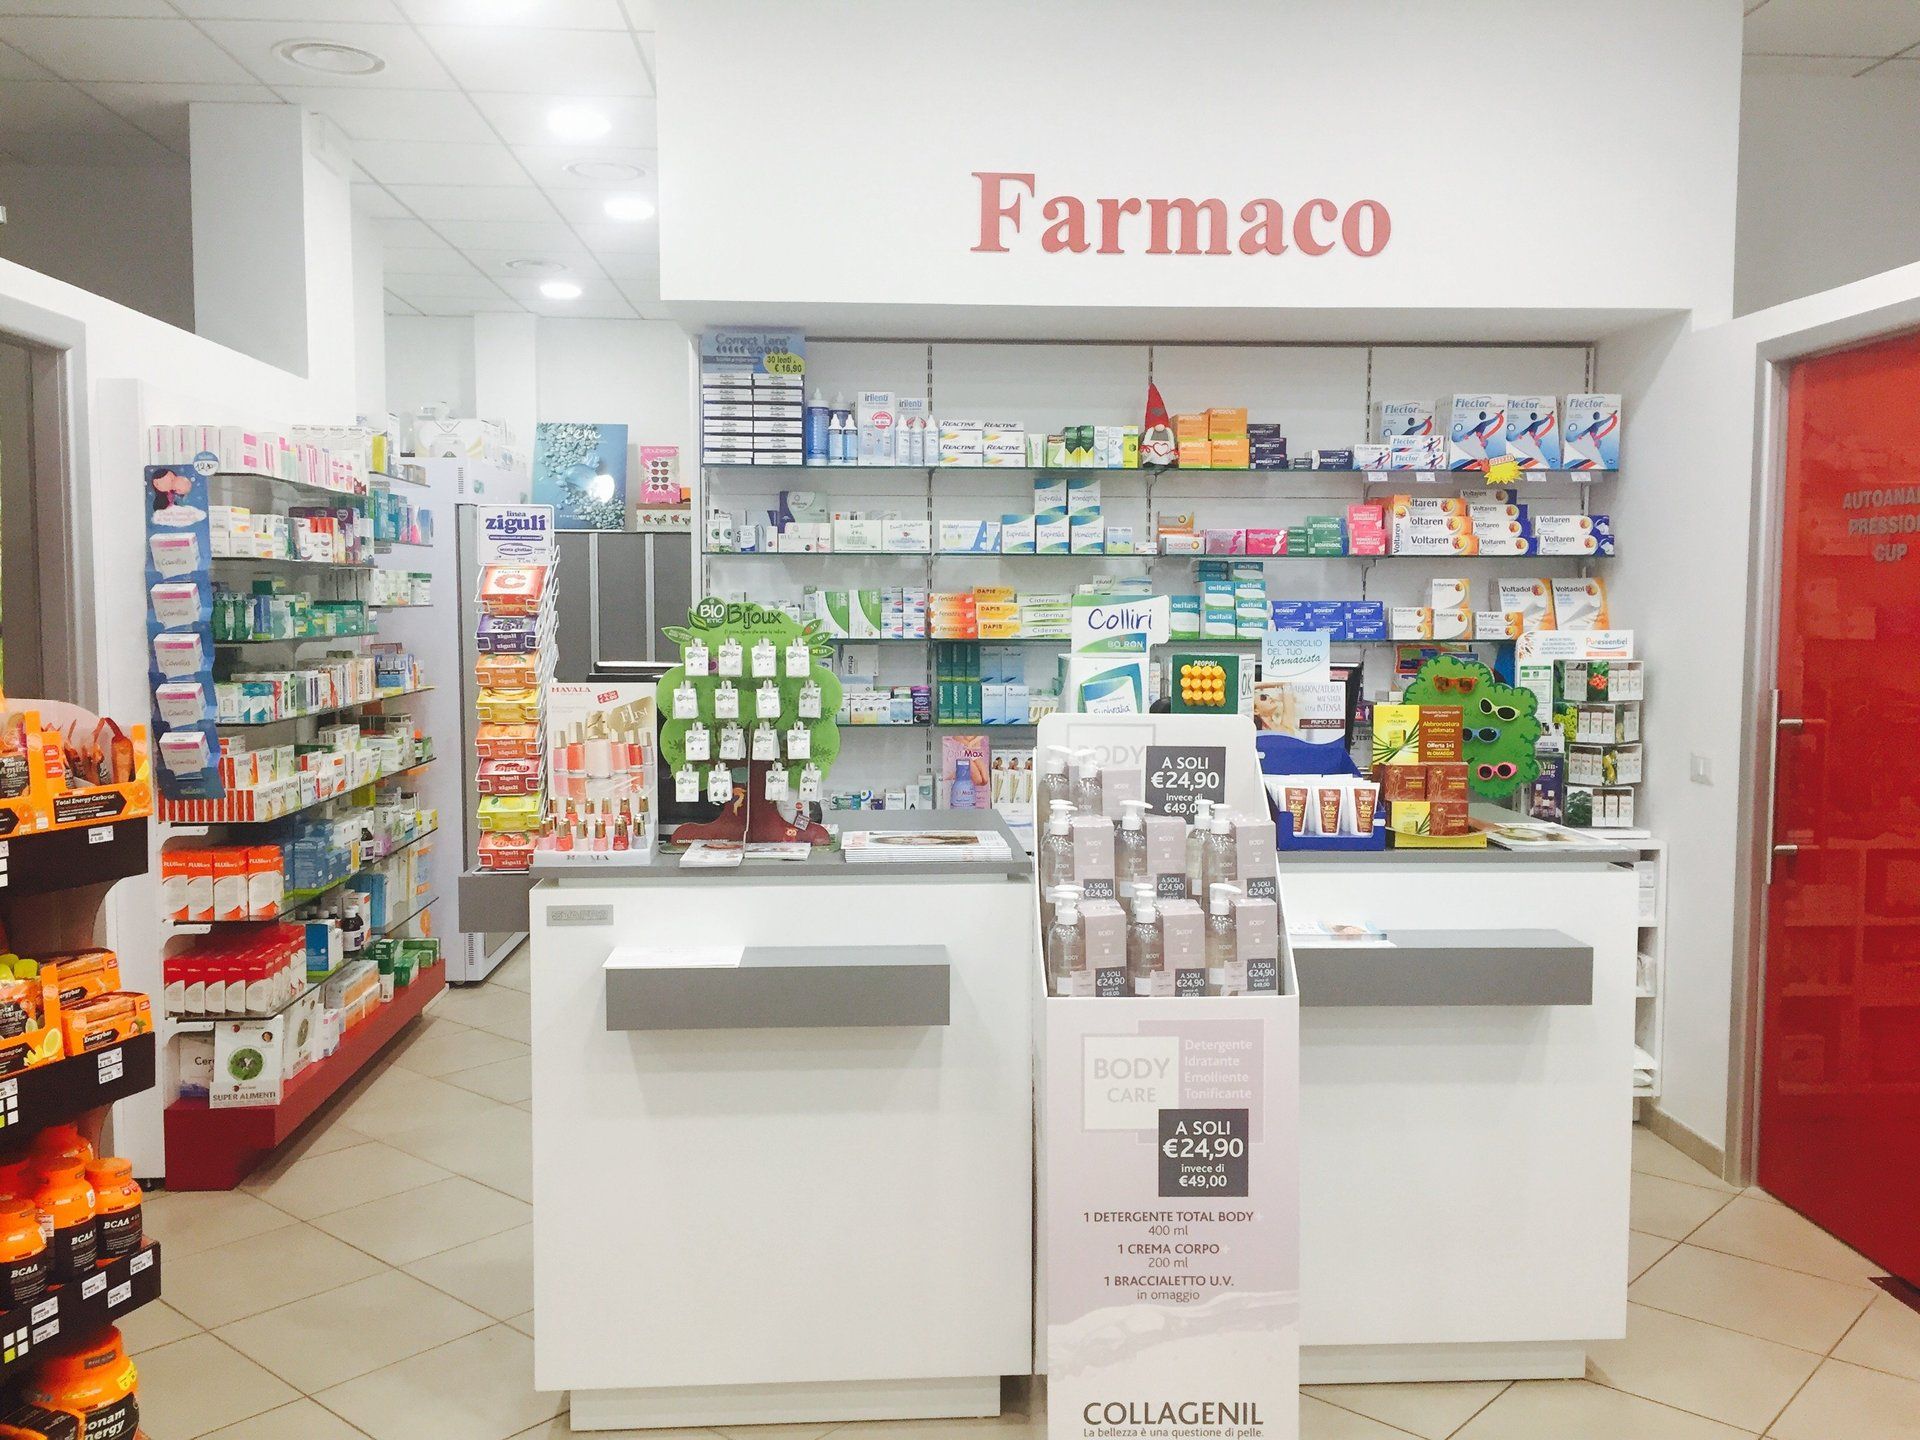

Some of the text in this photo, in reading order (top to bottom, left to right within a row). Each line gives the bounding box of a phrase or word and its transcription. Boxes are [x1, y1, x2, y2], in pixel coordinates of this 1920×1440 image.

[970, 171, 1392, 257] Farmaco
[1456, 398, 1490, 408] Flector
[1507, 400, 1539, 409] Flector
[1570, 399, 1603, 408] Flector
[1385, 405, 1417, 413] Flector
[1411, 536, 1449, 544] Voltaren
[1544, 535, 1575, 543] Voltaren
[700, 604, 725, 618] BIO
[727, 603, 782, 629] Bijoux
[1087, 608, 1152, 630] Colliri
[1267, 648, 1303, 656] DEL TUO
[1270, 654, 1321, 669] farmacista
[1161, 757, 1209, 769] A SOLI
[1150, 771, 1220, 792] €24,90
[72, 797, 91, 805] Energy
[1165, 793, 1192, 802] invece
[1085, 888, 1113, 897] €24,90
[1158, 882, 1185, 892] €24,90
[1248, 886, 1275, 896] €24,90
[1248, 967, 1275, 977] €24,90
[1097, 977, 1126, 987] €24,90
[1176, 978, 1205, 988] €24,90
[84, 1030, 112, 1042] Energybar
[1184, 1040, 1253, 1053] Detergente
[1184, 1056, 1240, 1067] Idratante
[1093, 1058, 1170, 1080] BODY
[1184, 1072, 1249, 1083] Emolliente
[212, 1091, 276, 1102] SUPER ALIMENTI
[1107, 1087, 1157, 1104] CARE
[1184, 1087, 1252, 1099] Tonificante
[1175, 1121, 1231, 1135] A SOLI
[1162, 1138, 1244, 1161] €24,90
[1181, 1163, 1225, 1173] invece di
[1178, 1175, 1228, 1189] €49,00
[1084, 1212, 1254, 1222] 1 DETERGENTE TOTAL BODY
[103, 1217, 130, 1229] BCAA
[1148, 1226, 1188, 1236] 400 ml
[71, 1230, 94, 1245] BCAA
[1117, 1244, 1220, 1255] 1 CREMA CORPO
[1148, 1258, 1188, 1268] 200 ml
[10, 1264, 38, 1279] BCAA
[1104, 1276, 1234, 1286] 1 BRACCIALETTO U.V.
[1137, 1290, 1200, 1303] in omaggio
[1083, 1402, 1264, 1425] COLLAGENIL
[1083, 1428, 1264, 1440] La bellezza è una questione di pelle.
